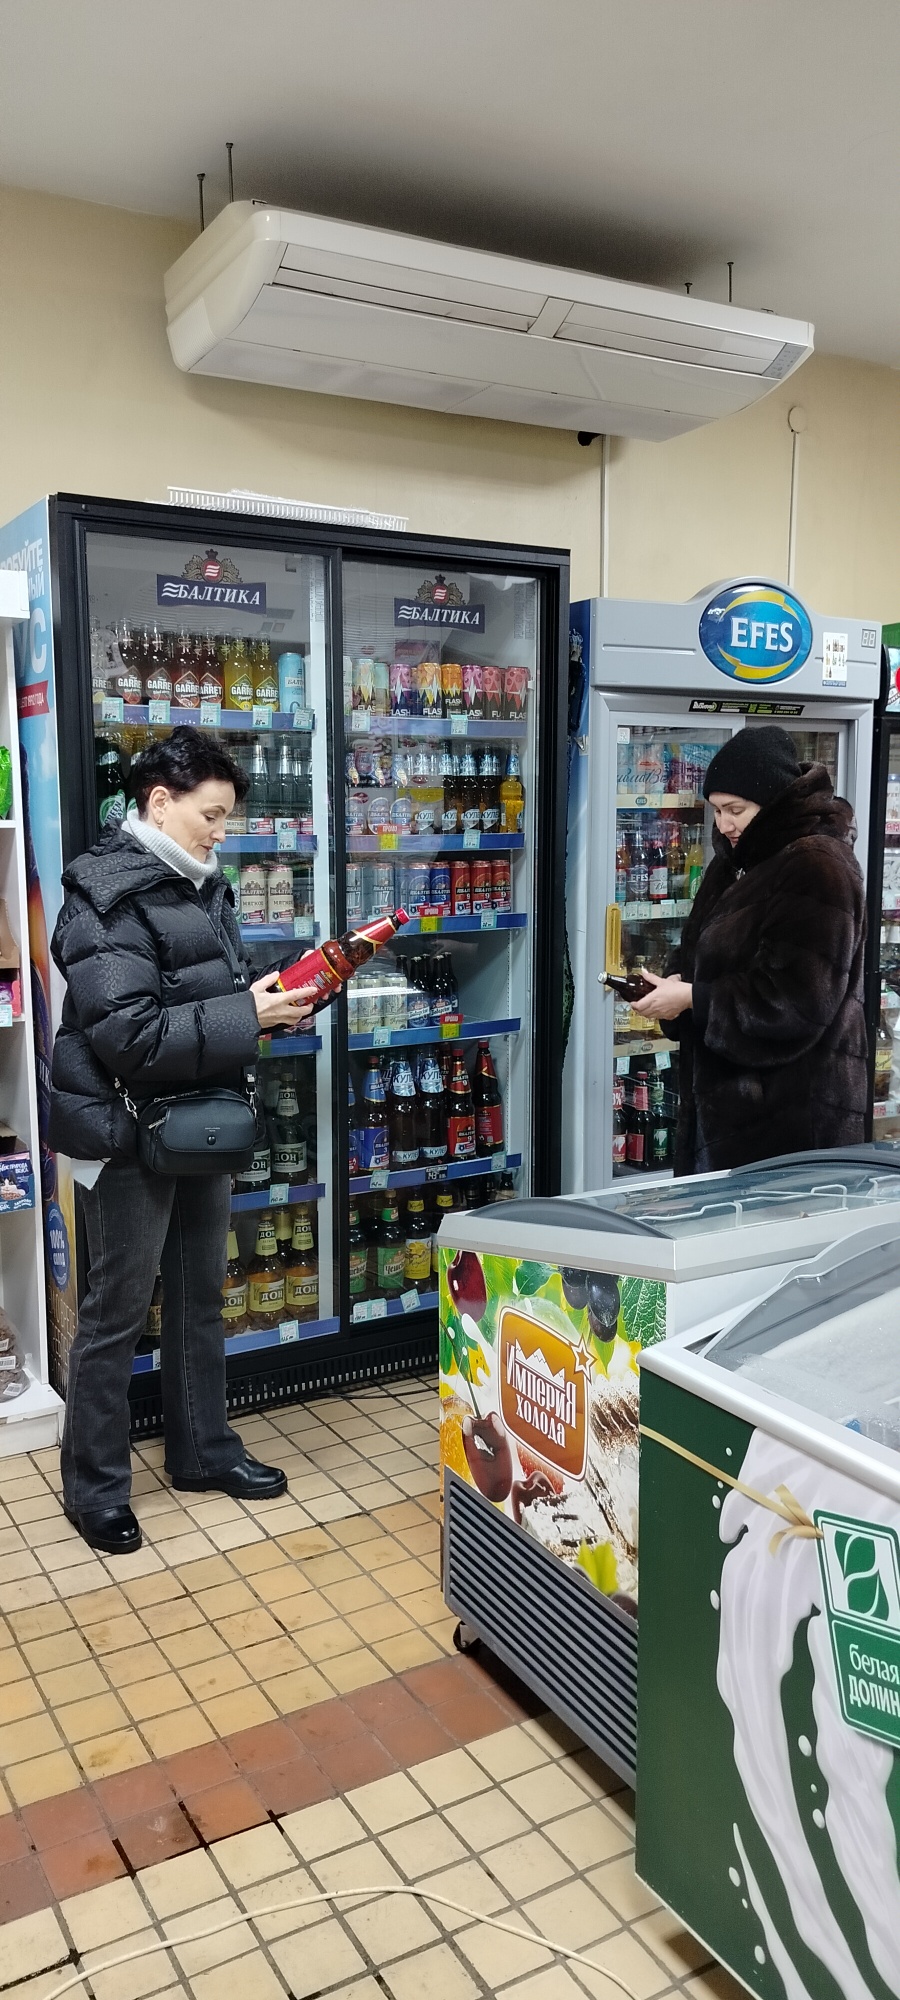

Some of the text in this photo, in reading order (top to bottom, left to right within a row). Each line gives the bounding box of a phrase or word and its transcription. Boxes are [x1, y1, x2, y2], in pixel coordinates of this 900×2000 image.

[177, 583, 260, 605] БАЛТИКА
[412, 606, 480, 625] БАЛТИКА
[730, 617, 793, 652] EFES
[632, 874, 648, 882] EFES
[383, 890, 389, 902] 7
[262, 1290, 283, 1300] ДОН
[294, 1285, 318, 1295] ДОН
[850, 1644, 900, 1685] белая
